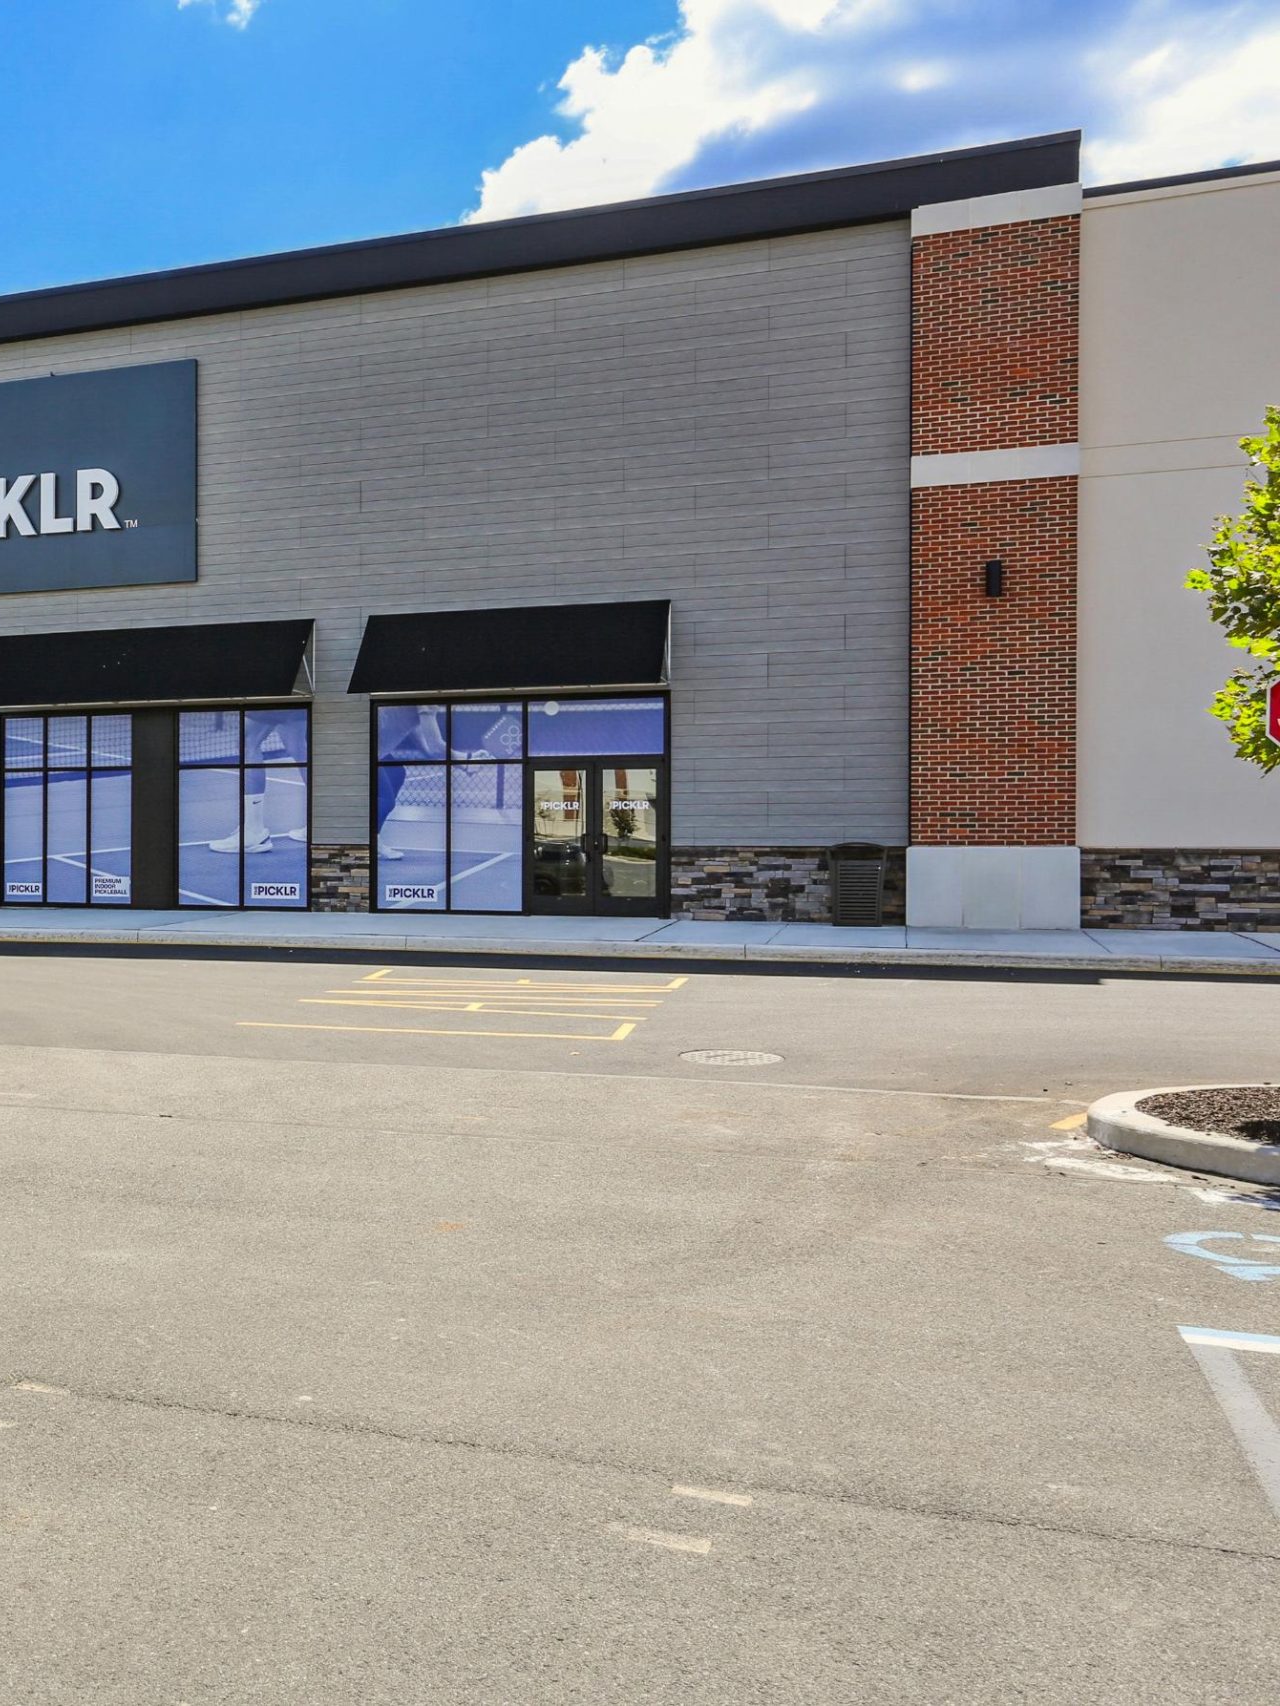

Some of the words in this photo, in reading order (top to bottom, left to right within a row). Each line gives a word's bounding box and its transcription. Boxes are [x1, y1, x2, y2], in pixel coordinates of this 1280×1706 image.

[543, 801, 580, 811] PICKLR
[612, 800, 651, 811] PICKLR
[11, 884, 40, 894] PICKLR
[257, 885, 298, 897] PICKLR
[392, 887, 435, 899] PICKLR
